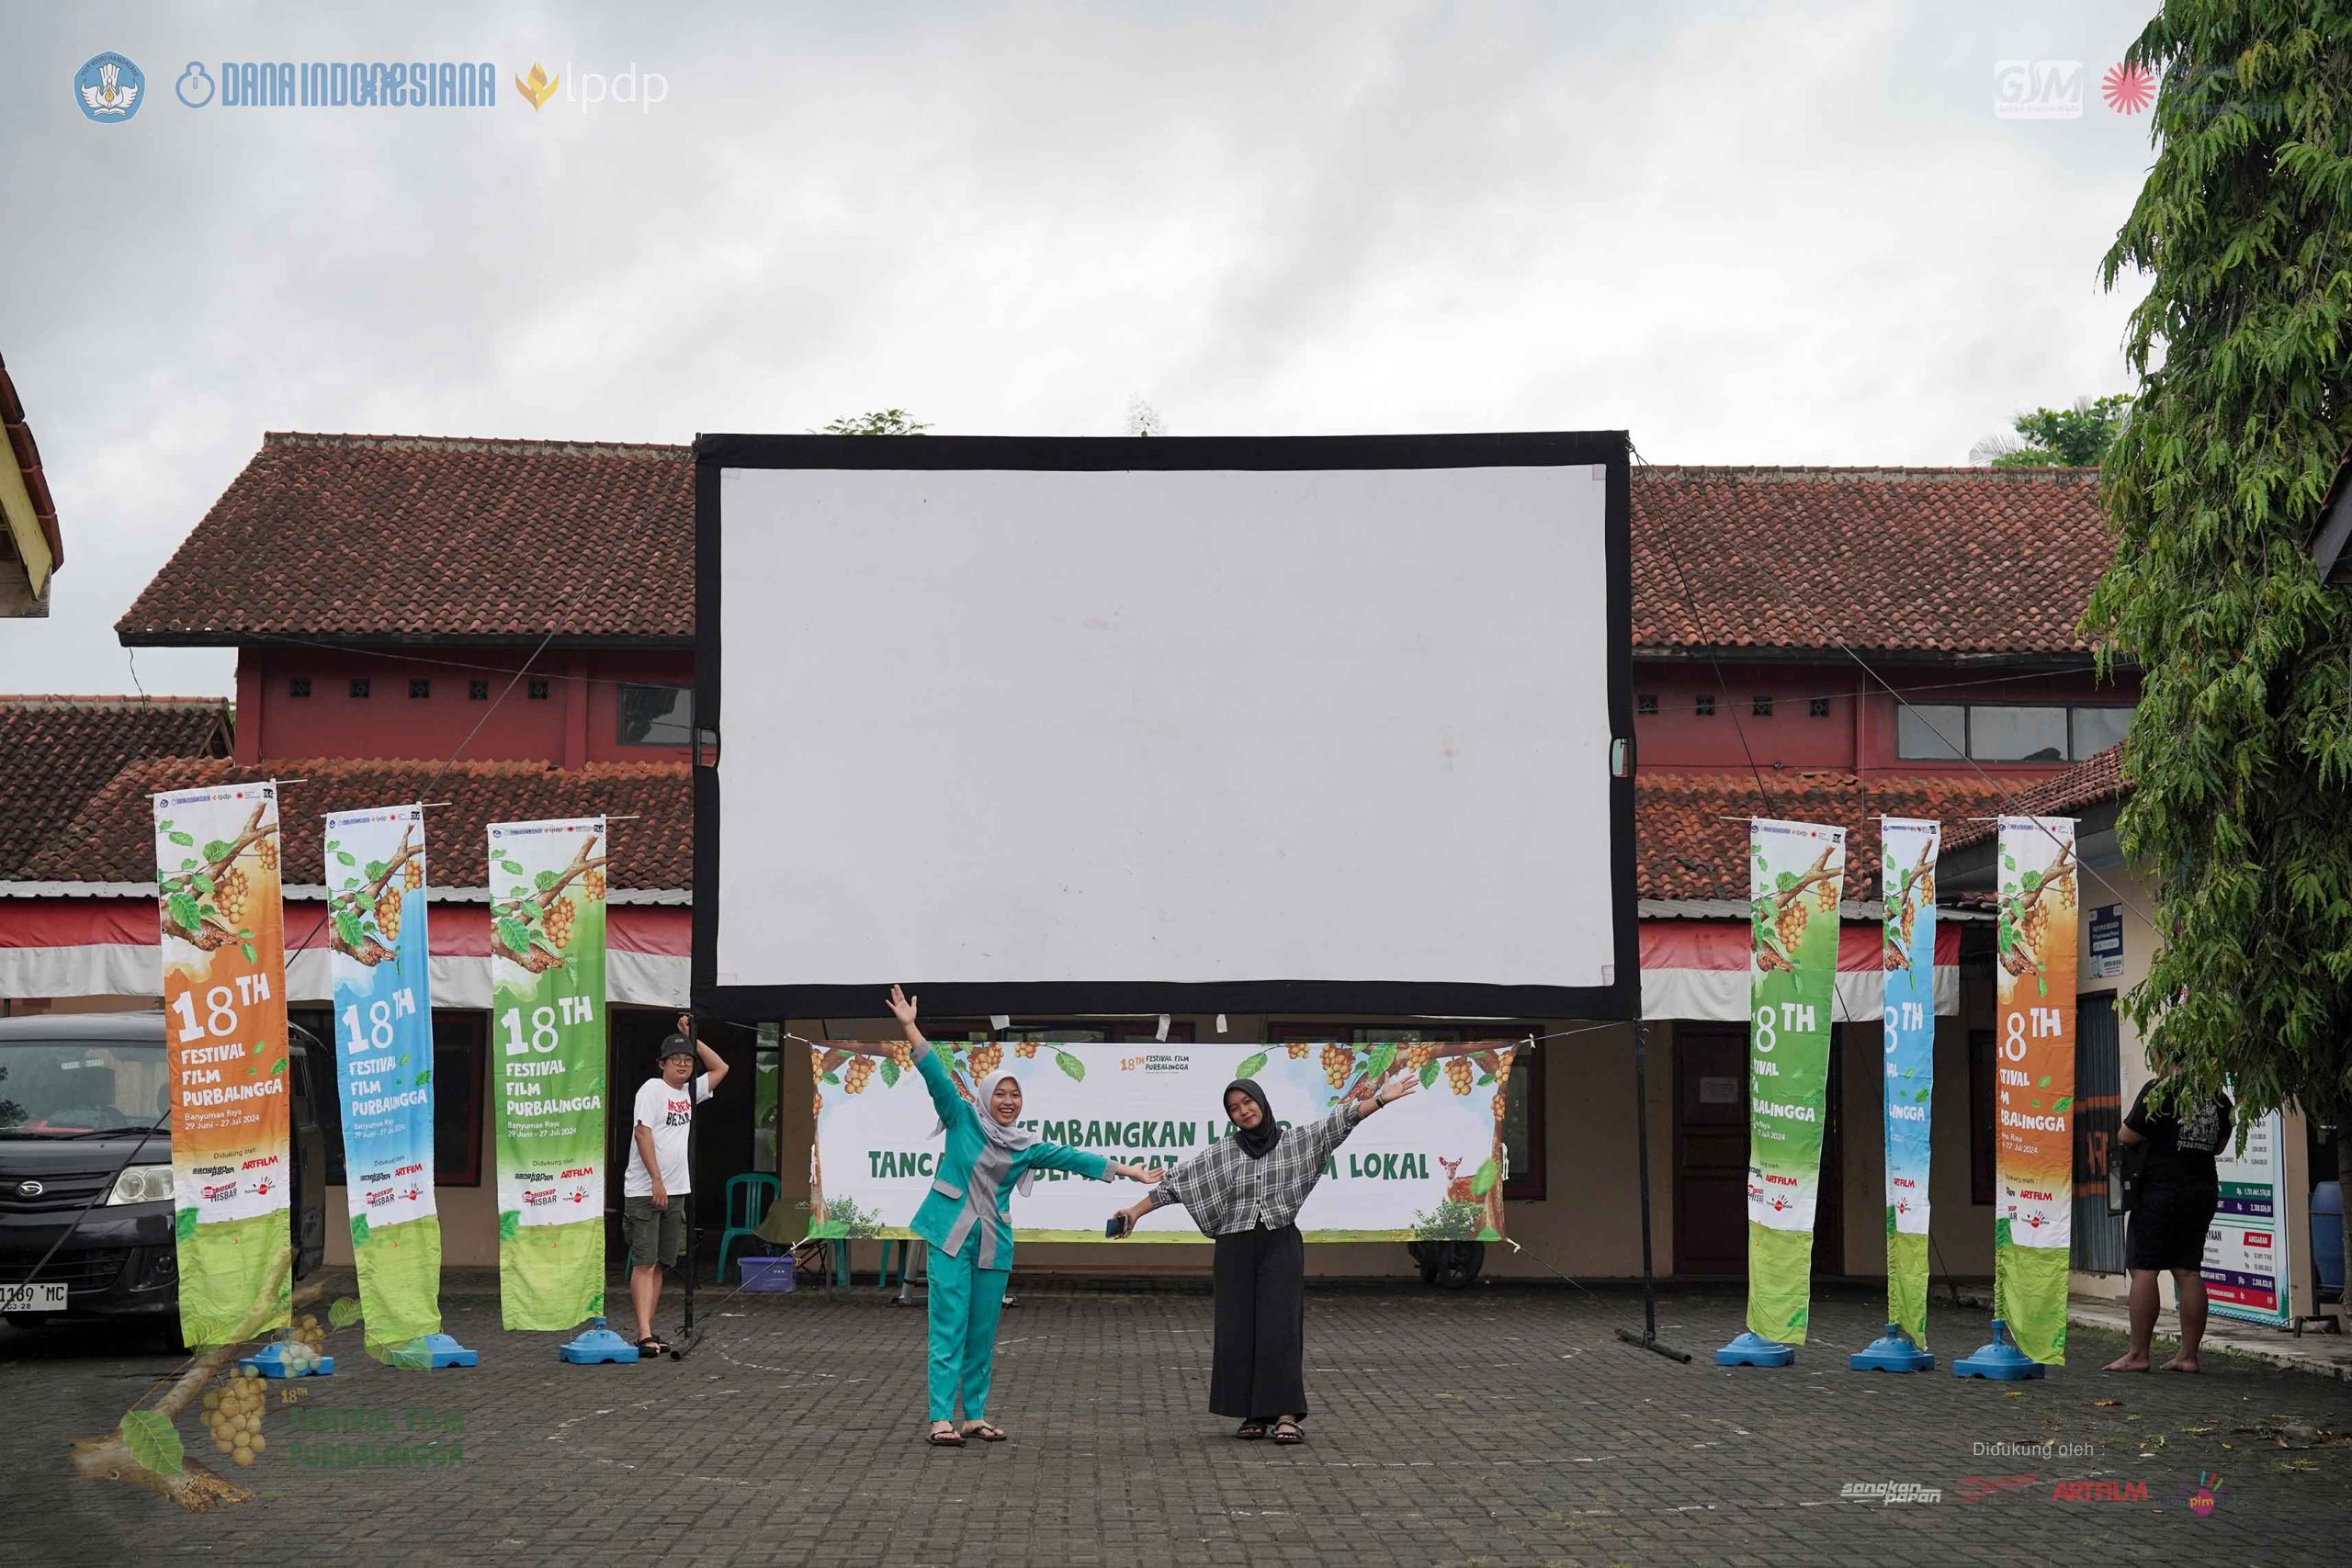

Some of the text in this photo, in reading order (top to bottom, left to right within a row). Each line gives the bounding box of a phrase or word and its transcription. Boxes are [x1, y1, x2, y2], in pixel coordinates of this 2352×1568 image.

[172, 973, 272, 1043] 18TH
[501, 996, 594, 1056] 18TH
[181, 1043, 246, 1066] FESTIVAL
[1146, 1055, 1172, 1063] FESTIVAL
[505, 1059, 566, 1077] FESTIVAL
[1120, 1055, 1146, 1072] 18TH
[1145, 1063, 1189, 1071] PURBALINGGA
[182, 1069, 221, 1086] FILM
[183, 1077, 283, 1107] PURBALINGGA
[505, 1082, 541, 1097] FILM
[506, 1095, 602, 1118] PURBALINGGA
[185, 1113, 225, 1122] Banyumas
[185, 1122, 196, 1131] 29
[197, 1122, 214, 1130] Juni
[220, 1119, 230, 1127] 27
[243, 1114, 260, 1124] 2024
[507, 1121, 544, 1131] Banyumas
[538, 1129, 548, 1137] 27
[1770, 1132, 1786, 1141] 2024
[213, 1150, 243, 1159] Didukung
[2023, 1145, 2038, 1154] 2024
[242, 1155, 278, 1171] ARTFILM
[1350, 1152, 1430, 1180] LOKAL
[560, 1167, 594, 1179] ARTFILM
[1765, 1175, 1797, 1187] ARTFILM
[210, 1188, 238, 1203] MISBAR
[2019, 1190, 2052, 1201] ARTFILM
[46, 1286, 64, 1302] MC
